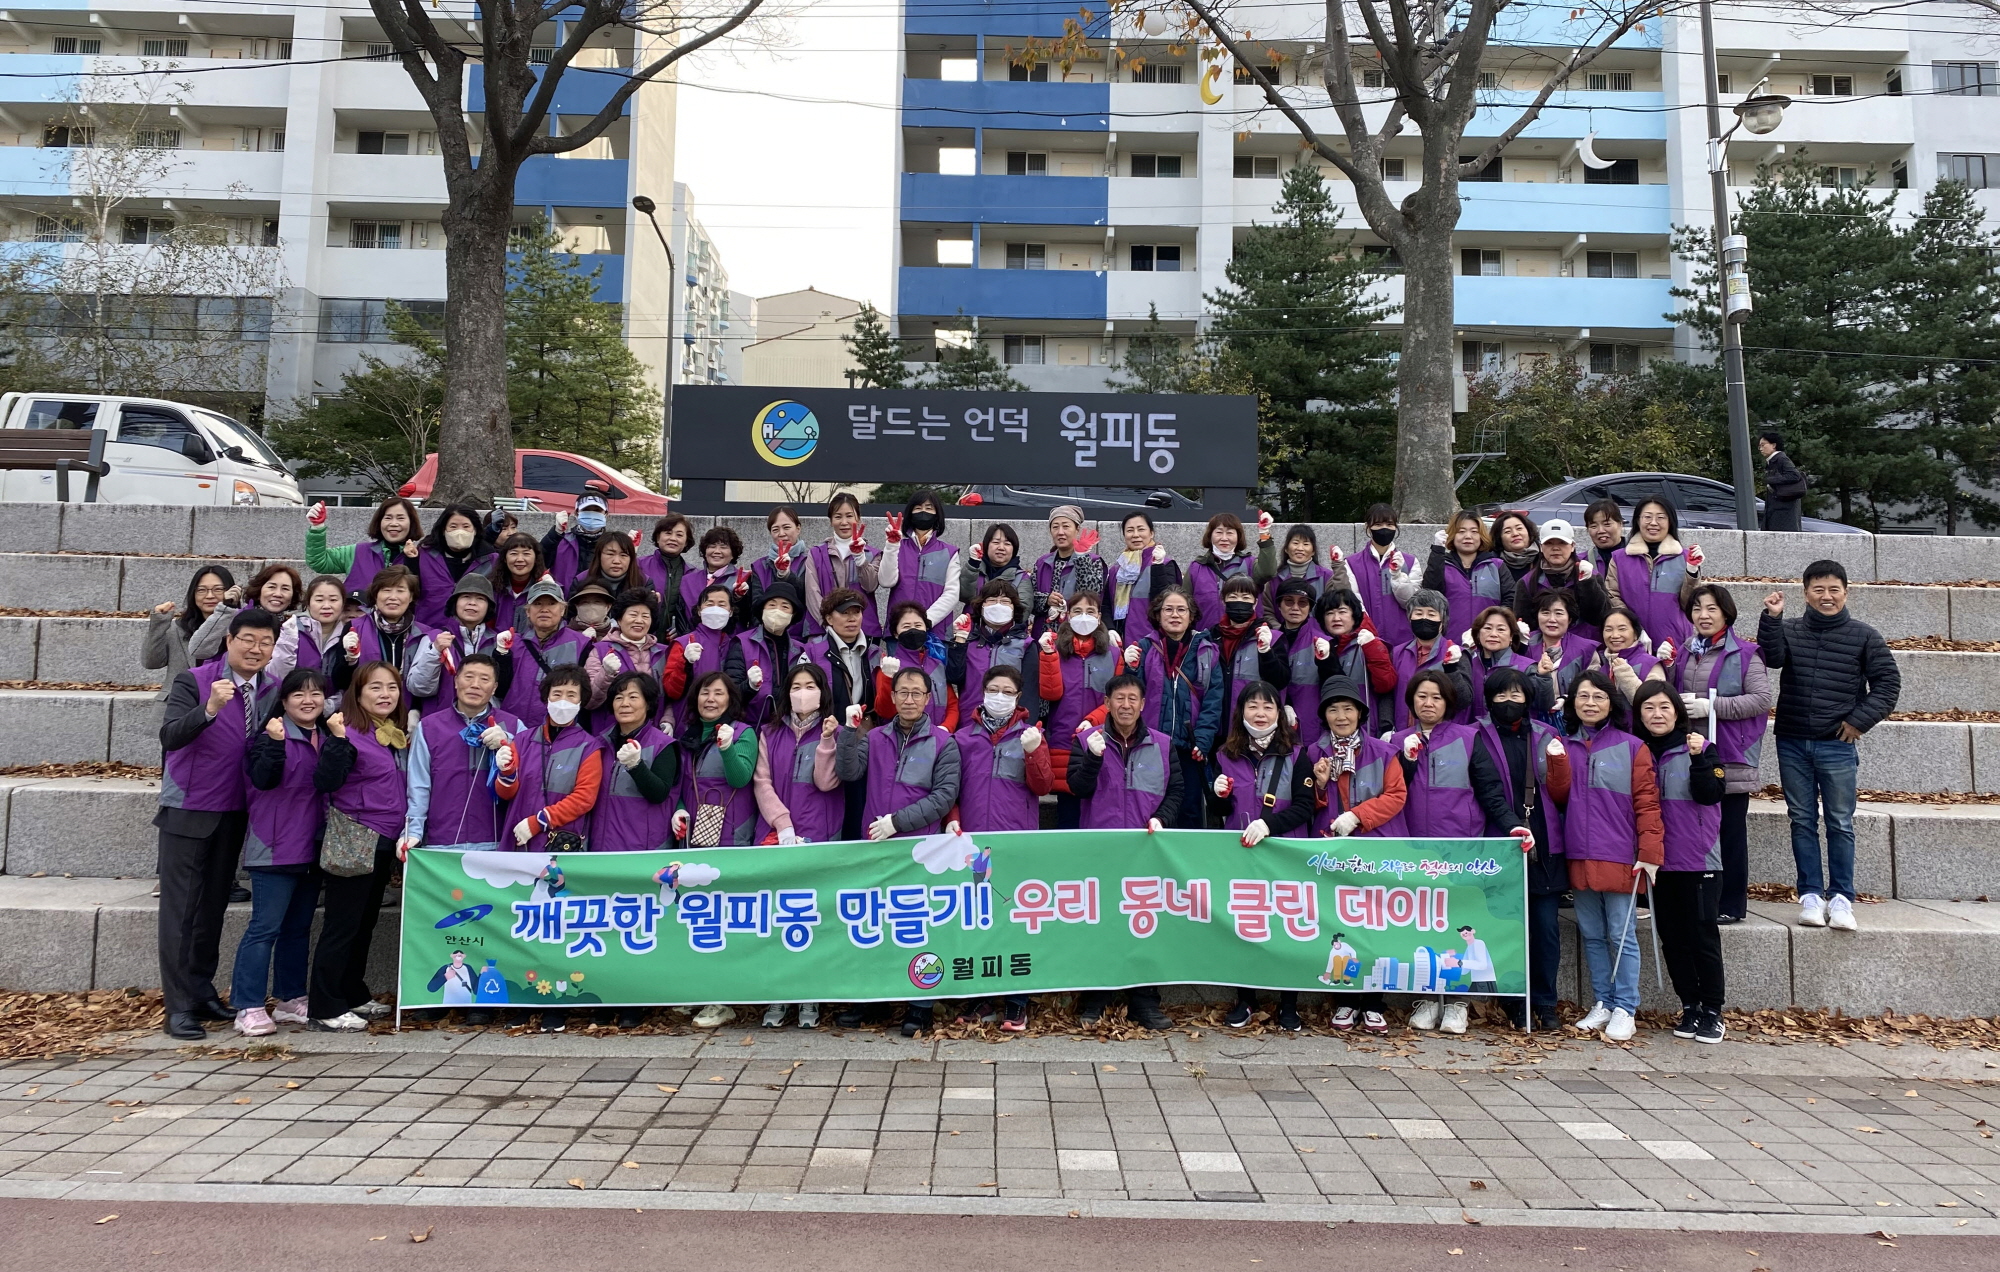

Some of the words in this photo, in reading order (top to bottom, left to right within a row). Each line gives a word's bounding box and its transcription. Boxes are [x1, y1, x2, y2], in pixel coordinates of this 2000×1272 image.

[847, 404, 951, 441] 달드는
[963, 406, 1029, 443] 언덕
[1060, 403, 1180, 475] 월피동
[1308, 852, 1347, 875] 시민과
[1347, 855, 1376, 874] 함께,
[1378, 859, 1416, 880] 자유로운
[1419, 859, 1463, 879] 혁신도시
[1466, 858, 1502, 875] 안산
[445, 935, 484, 947] 안산시
[512, 895, 662, 956] 깨끗한
[677, 890, 820, 951] 월피동
[837, 881, 993, 949] 만들기!
[1011, 877, 1099, 932] 우리
[1121, 877, 1210, 937] 동네
[1228, 880, 1319, 940] 클린
[1335, 885, 1449, 932] 데이!
